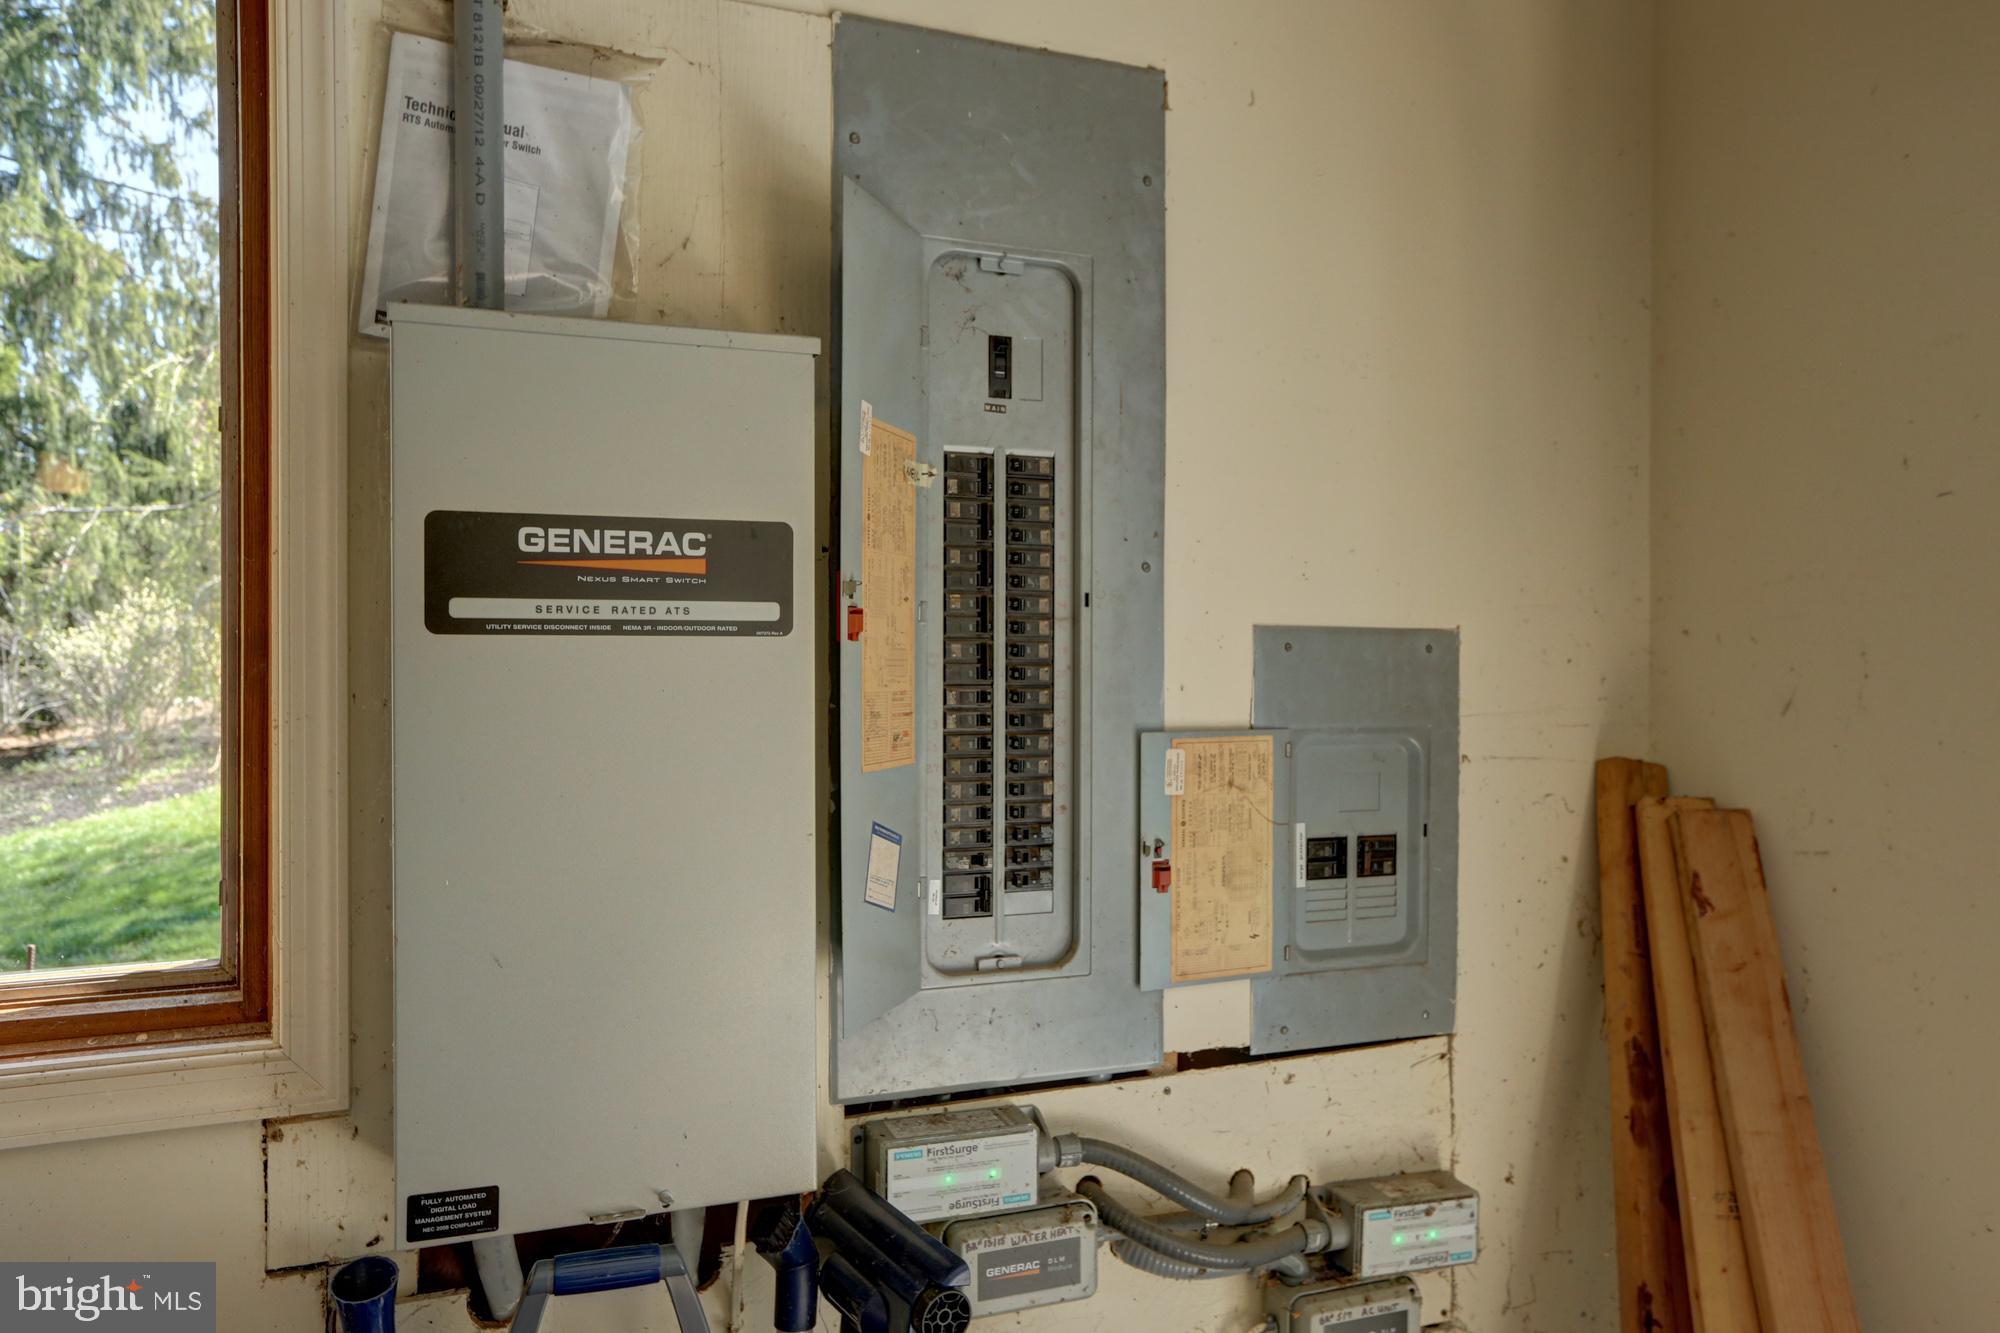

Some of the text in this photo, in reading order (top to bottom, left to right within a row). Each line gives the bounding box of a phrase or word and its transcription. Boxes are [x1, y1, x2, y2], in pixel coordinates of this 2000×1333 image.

[473, 73, 485, 147] 09/27/12
[404, 96, 525, 139] Technic ual
[402, 113, 422, 125] RTS
[424, 118, 456, 133] Autom
[511, 140, 542, 155] Switch
[517, 526, 707, 557] GENERAC
[535, 604, 691, 616] SERVICE RATED ATS
[485, 623, 512, 631] UTILITY
[589, 624, 612, 632] INSIDE
[926, 1143, 978, 1158] FirstSurge
[421, 1193, 486, 1206] FULLY AUTOMATED
[430, 1205, 457, 1214] DIGITAL
[415, 1210, 492, 1224] MANAGEMENT SYSTEM
[450, 1220, 485, 1229] COMPLIANT
[1011, 1231, 1047, 1246] WATER
[986, 1260, 1040, 1278] GENERAC
[1361, 1307, 1375, 1317] AC
[1377, 1303, 1400, 1313] UNIT
